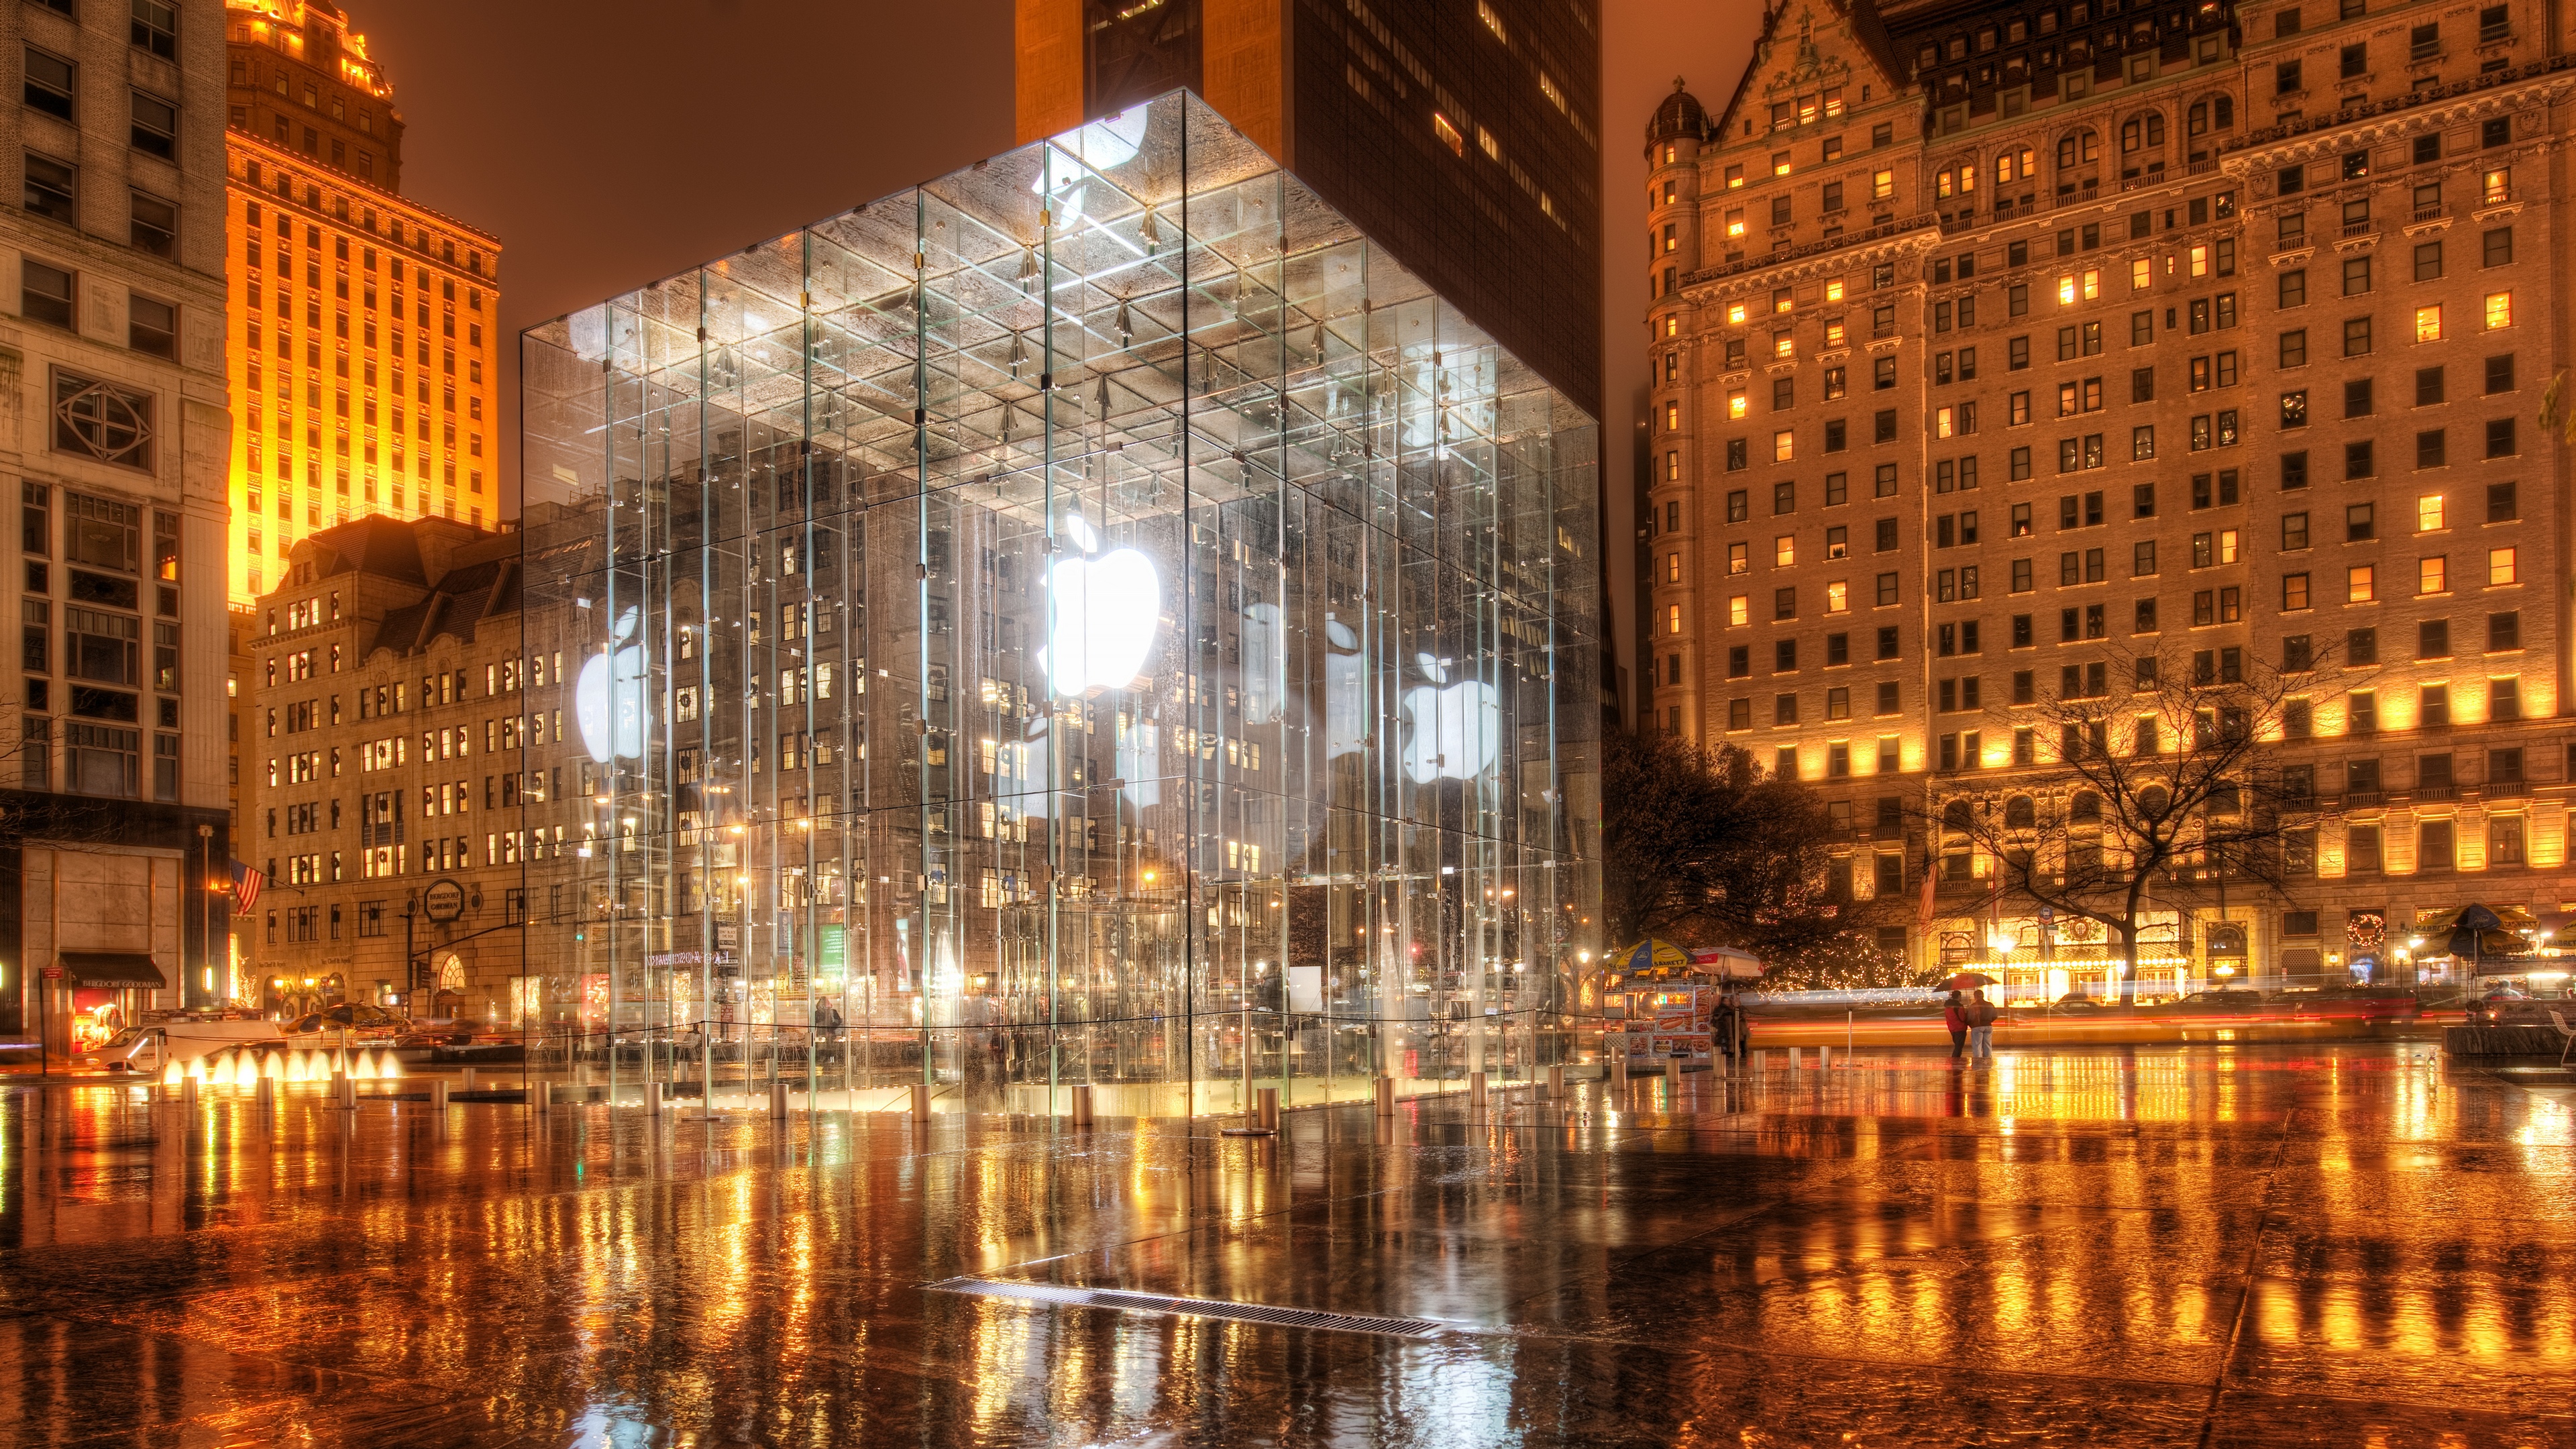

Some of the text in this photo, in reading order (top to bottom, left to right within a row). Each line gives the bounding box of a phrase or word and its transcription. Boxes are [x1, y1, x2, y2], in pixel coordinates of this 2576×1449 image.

[429, 892, 460, 900] BERGDORF
[431, 902, 458, 910] GOODMAN
[1654, 959, 1684, 967] SABRETT
